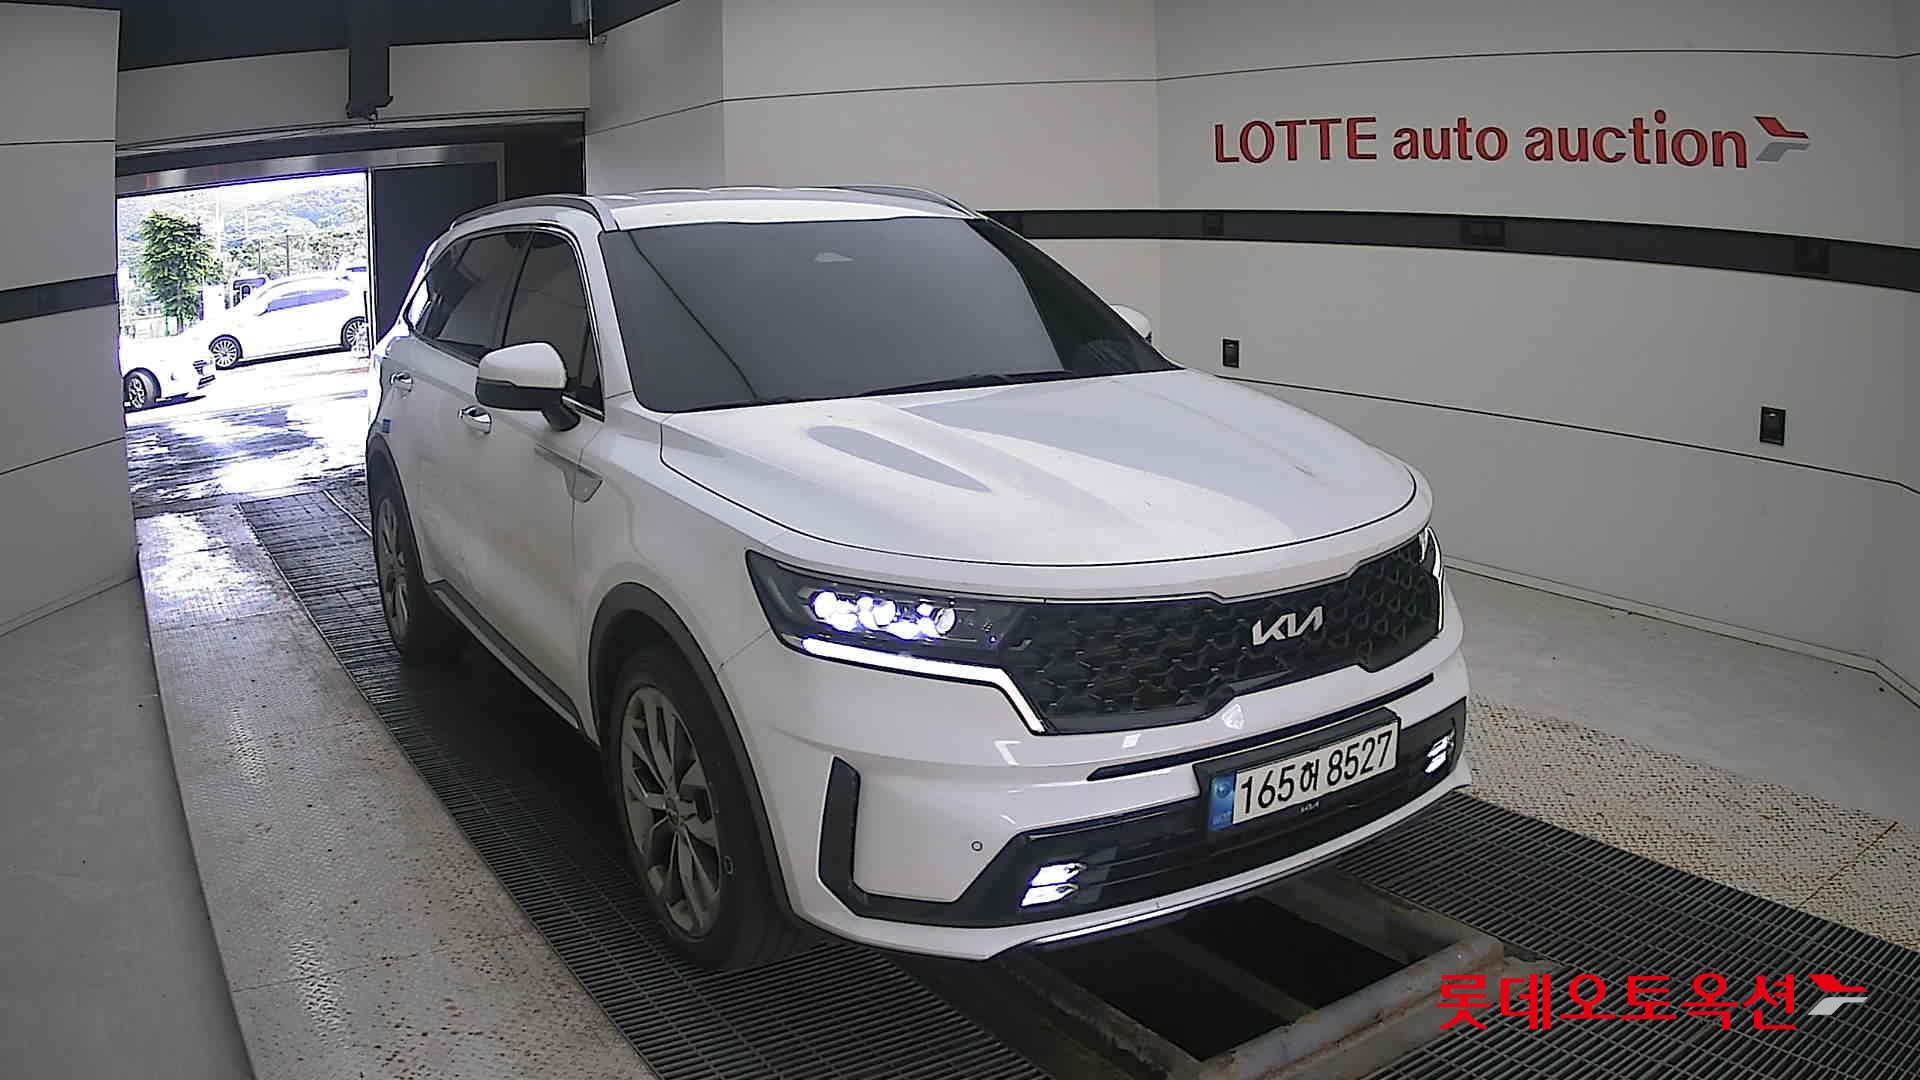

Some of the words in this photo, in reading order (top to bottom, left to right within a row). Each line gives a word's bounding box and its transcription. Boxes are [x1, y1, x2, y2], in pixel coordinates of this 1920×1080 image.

[1214, 116, 1377, 163] LOTTE
[1393, 117, 1508, 161] auto
[1524, 109, 1747, 168] auction
[1252, 606, 1323, 645] KIA
[1241, 759, 1320, 814] 165허
[1327, 731, 1392, 786] 8527
